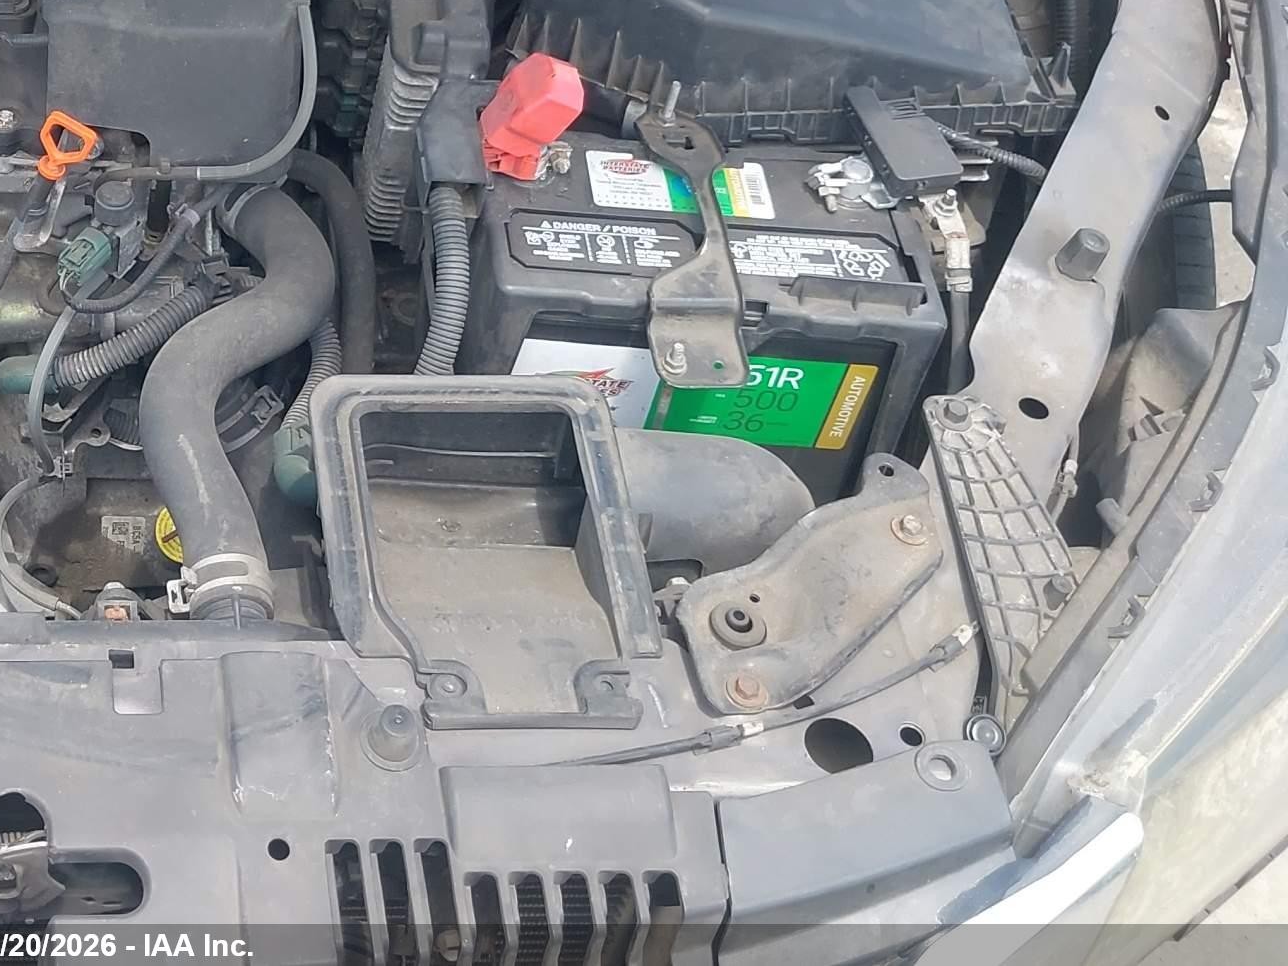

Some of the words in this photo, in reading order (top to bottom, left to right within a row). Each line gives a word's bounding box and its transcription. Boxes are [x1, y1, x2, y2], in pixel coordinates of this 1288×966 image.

[553, 221, 601, 232] DANGER
[612, 224, 656, 236] POISON
[745, 363, 805, 390] 51R
[733, 387, 799, 412] 500
[829, 376, 867, 438] AUTOMOTIVE
